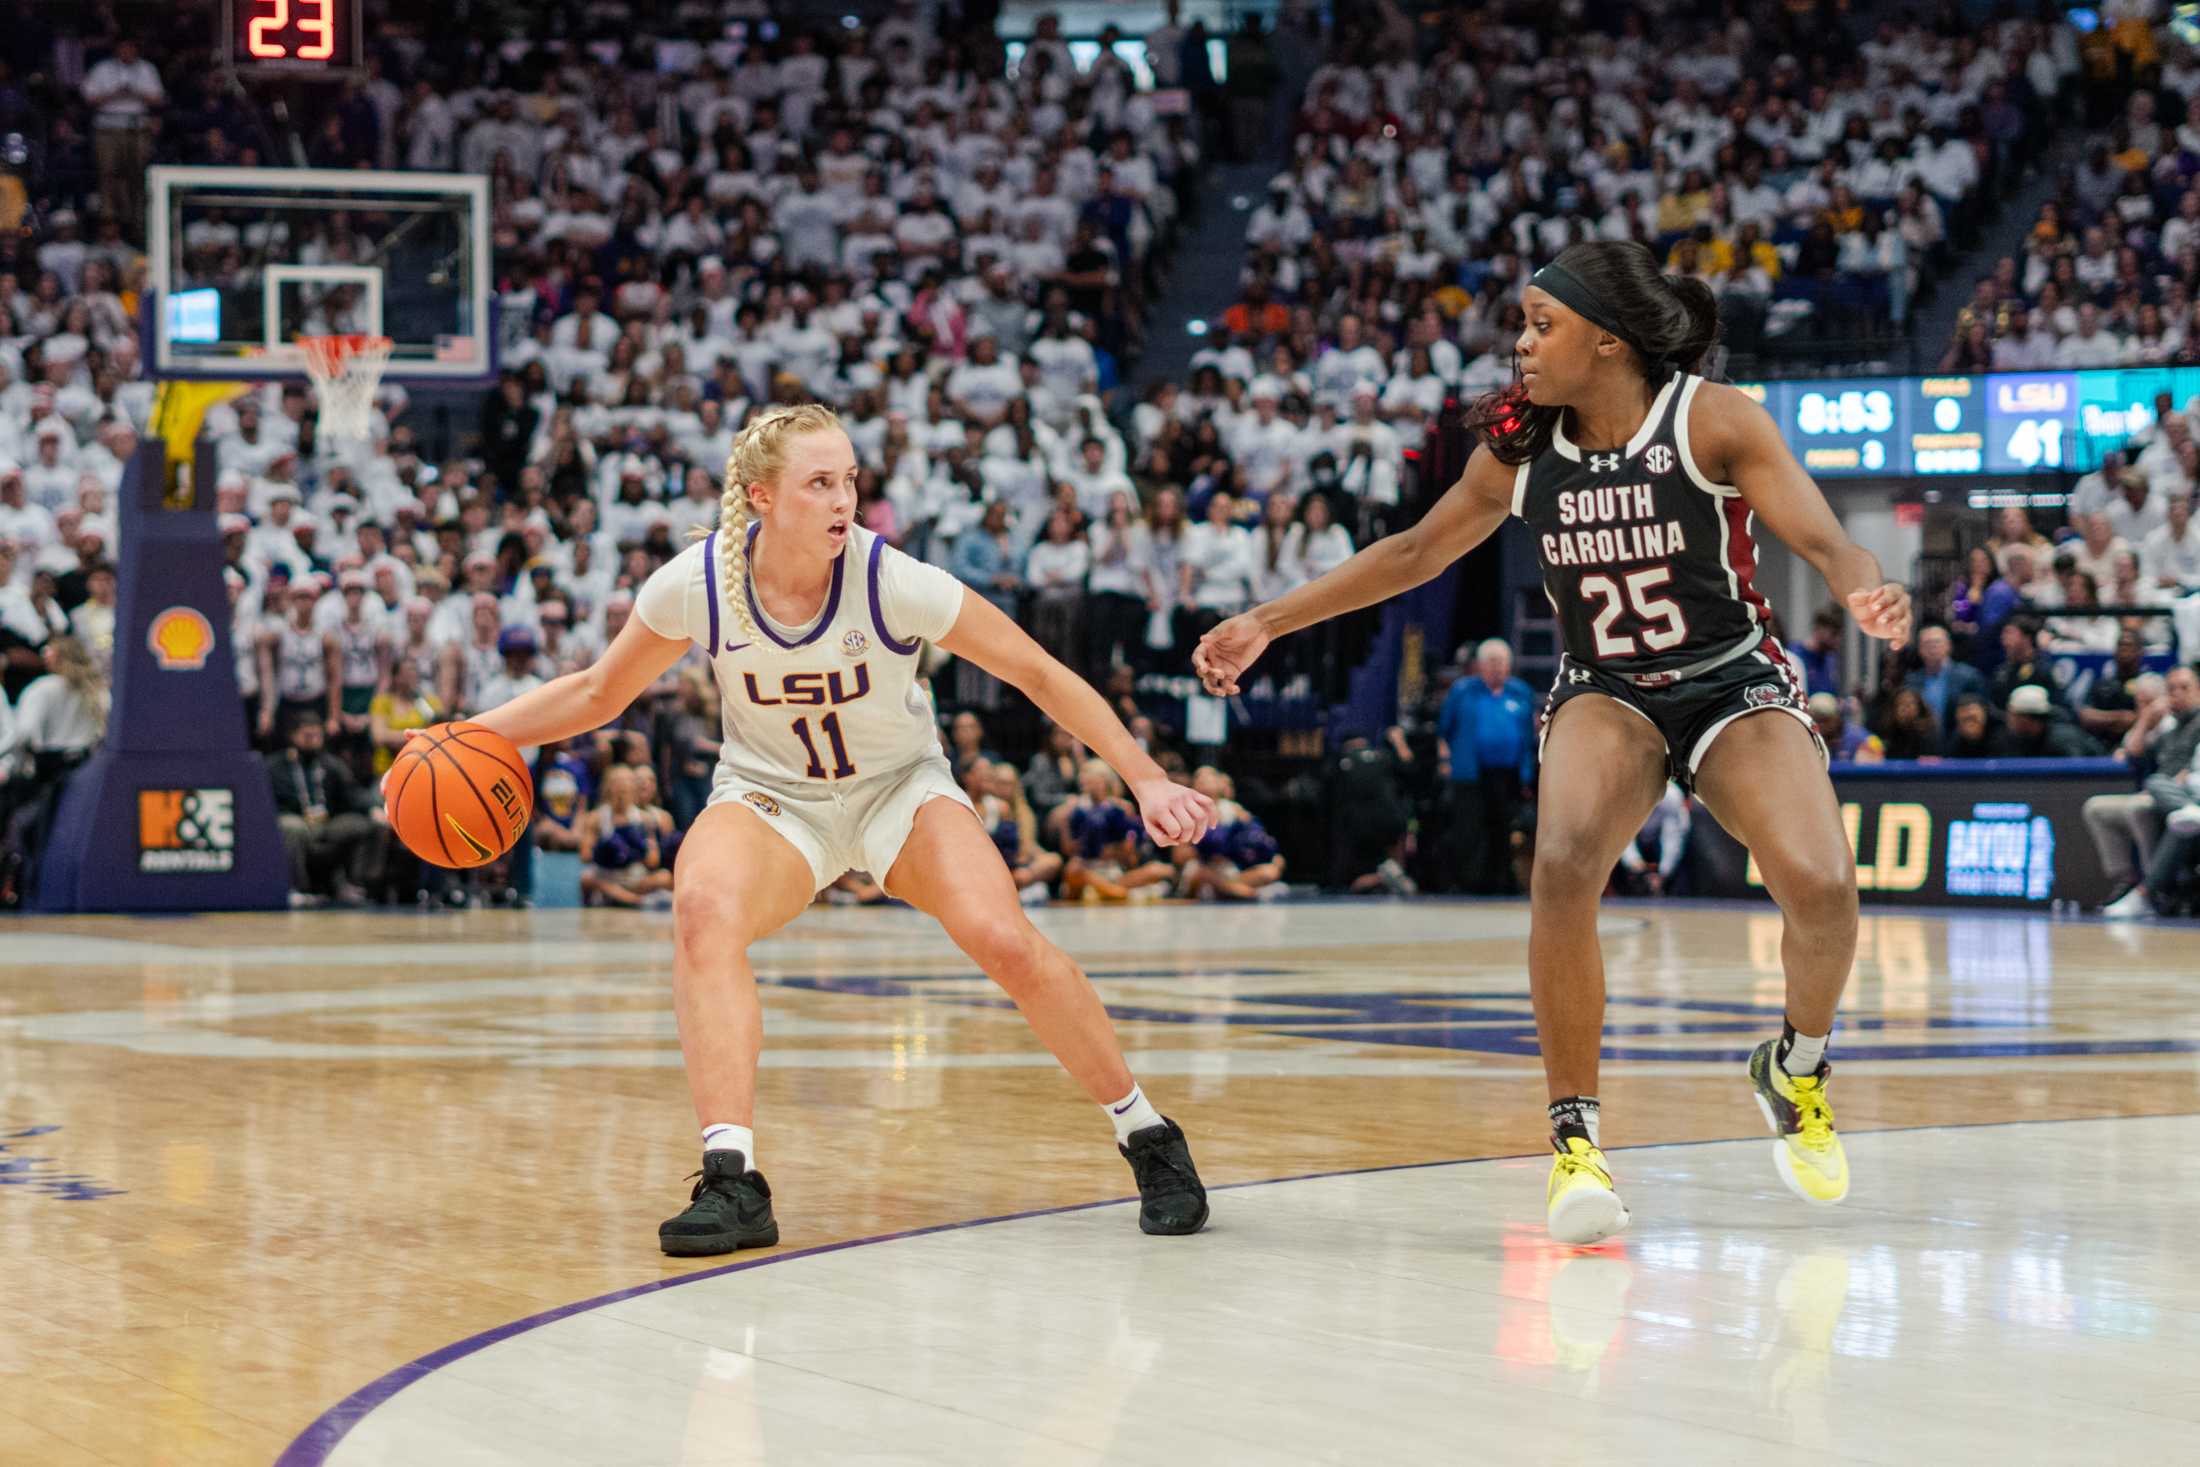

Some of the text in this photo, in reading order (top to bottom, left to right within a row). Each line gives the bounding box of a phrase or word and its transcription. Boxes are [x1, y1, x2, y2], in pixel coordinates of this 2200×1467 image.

[248, 0, 333, 59] 23
[1798, 390, 1893, 435] 8:53
[1998, 382, 2067, 412] LSU
[1646, 445, 1674, 474] SEC
[2006, 418, 2062, 468] 41
[1557, 483, 1655, 526] SOUTH
[1541, 520, 1687, 567] CAROLINA
[1578, 564, 1690, 660] 25
[741, 661, 871, 706] LSU
[790, 710, 857, 780] 11
[139, 789, 234, 849] H&E
